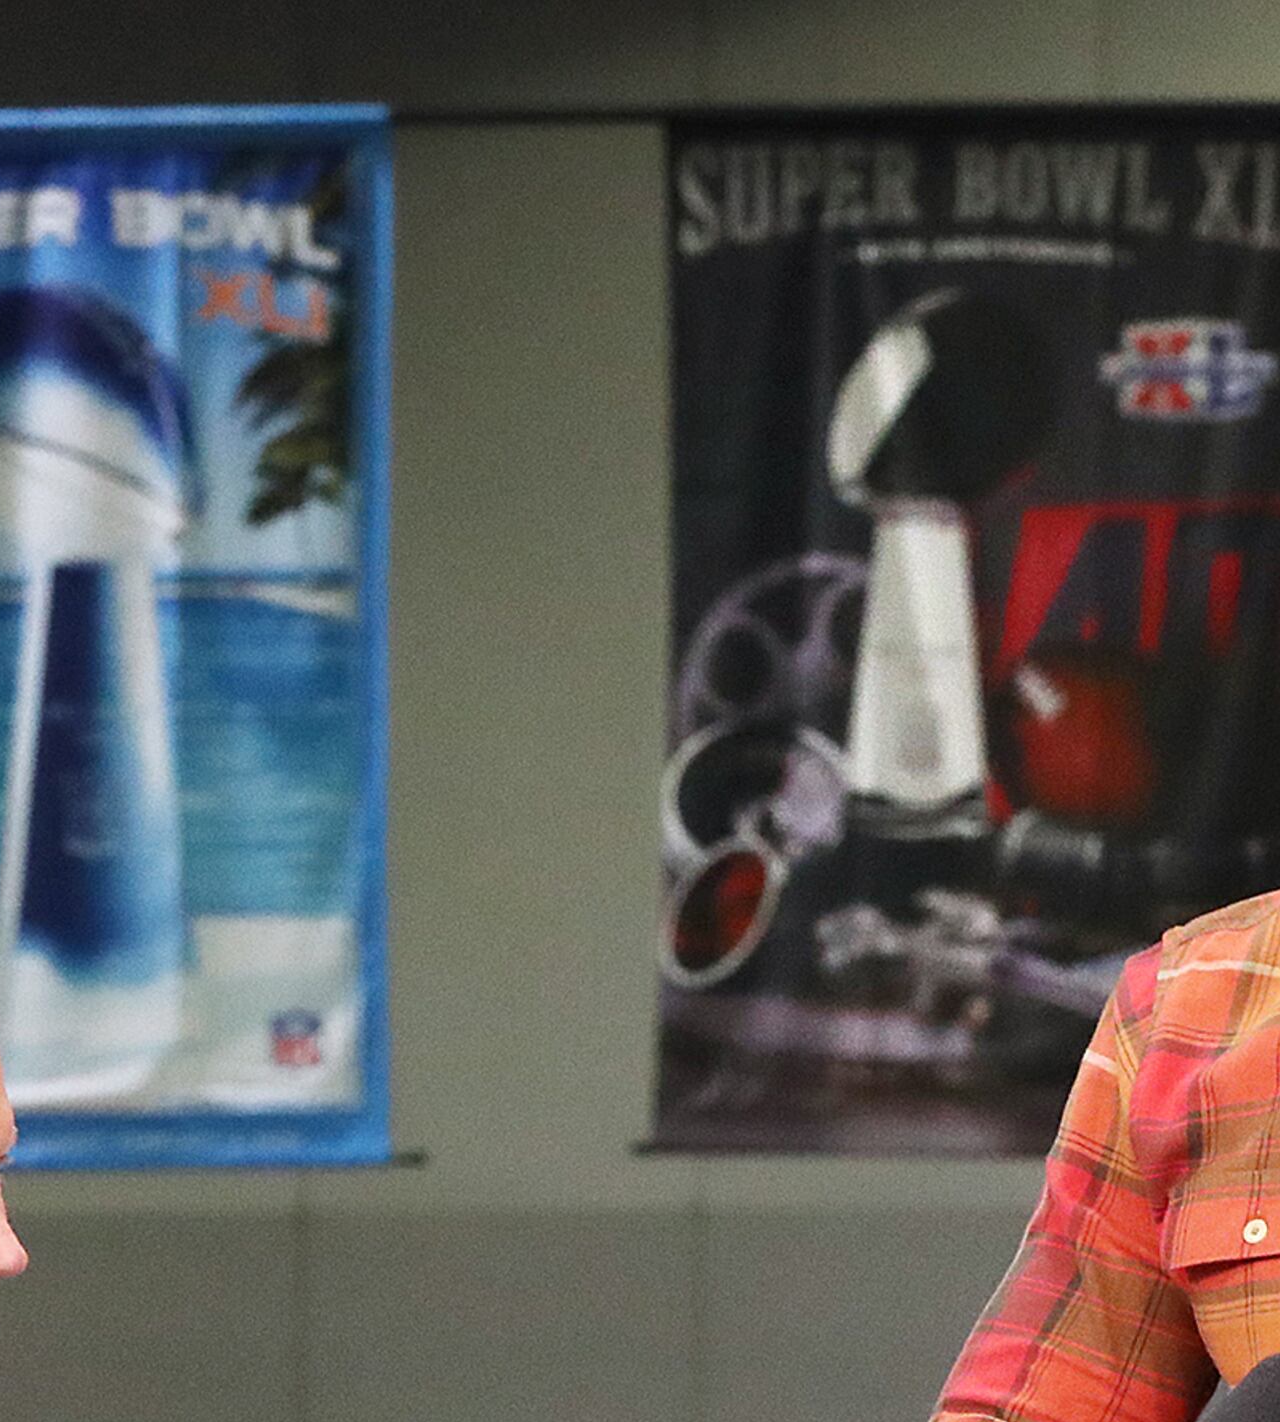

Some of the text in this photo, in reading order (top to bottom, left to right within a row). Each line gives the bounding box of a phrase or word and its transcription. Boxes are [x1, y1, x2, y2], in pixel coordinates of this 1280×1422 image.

[109, 190, 341, 268] BOWL
[676, 142, 920, 257] SUPER
[954, 142, 1172, 228] BOWL
[195, 269, 332, 343] XLI
